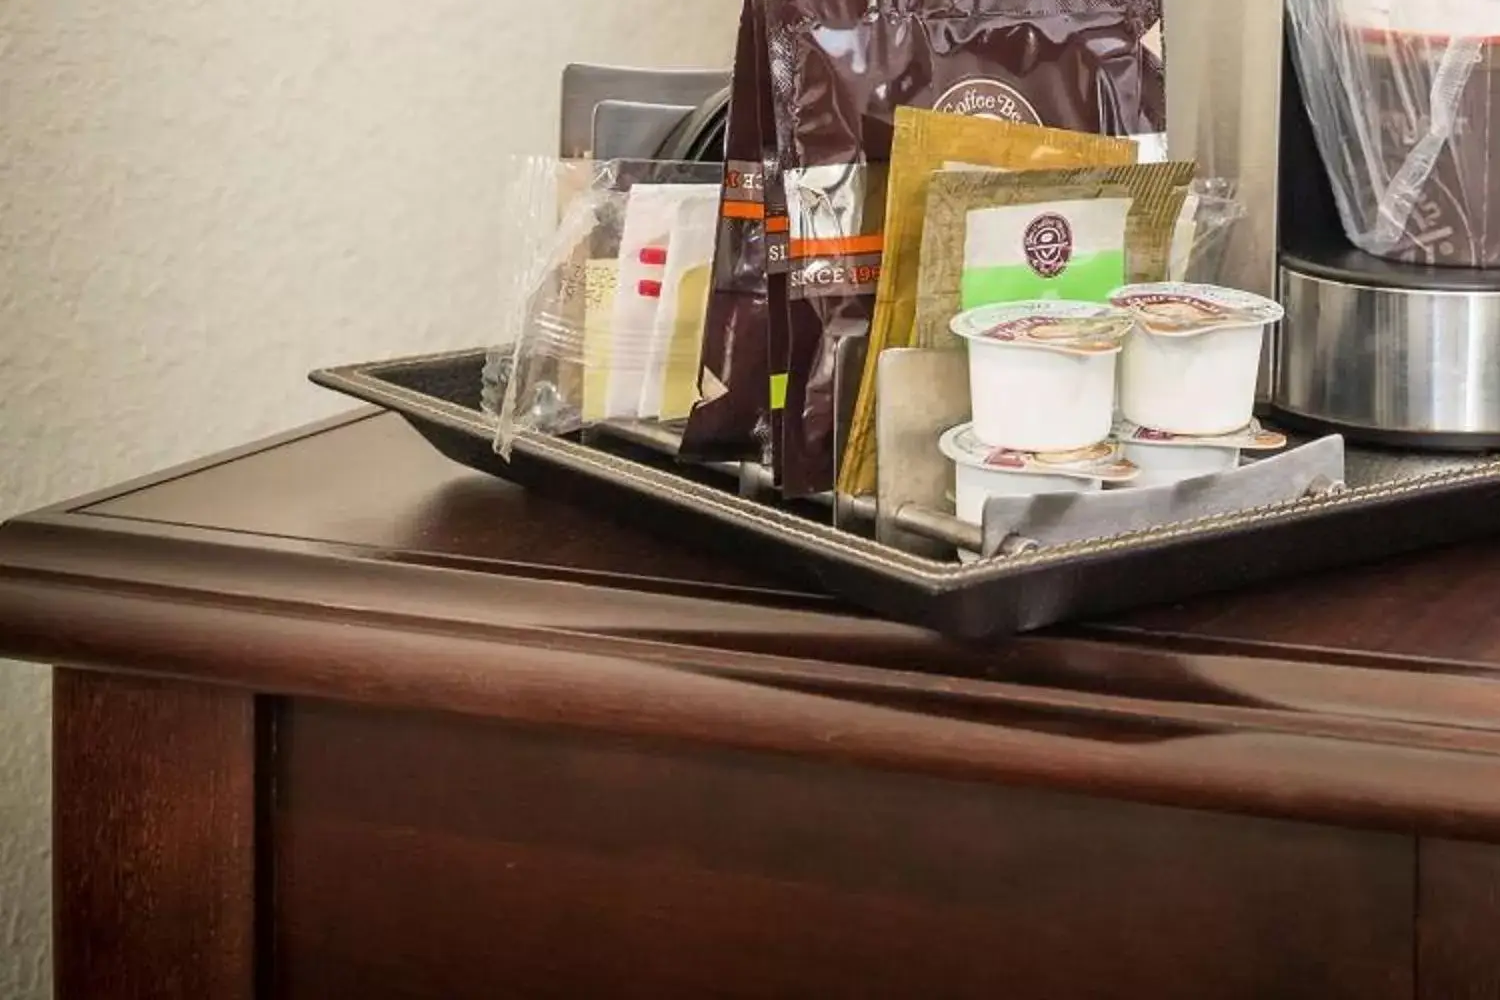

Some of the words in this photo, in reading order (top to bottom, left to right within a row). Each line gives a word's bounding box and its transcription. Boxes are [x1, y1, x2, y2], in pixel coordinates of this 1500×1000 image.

[943, 88, 996, 115] Coffee
[997, 92, 1026, 125] Be
[849, 264, 880, 284] 196
